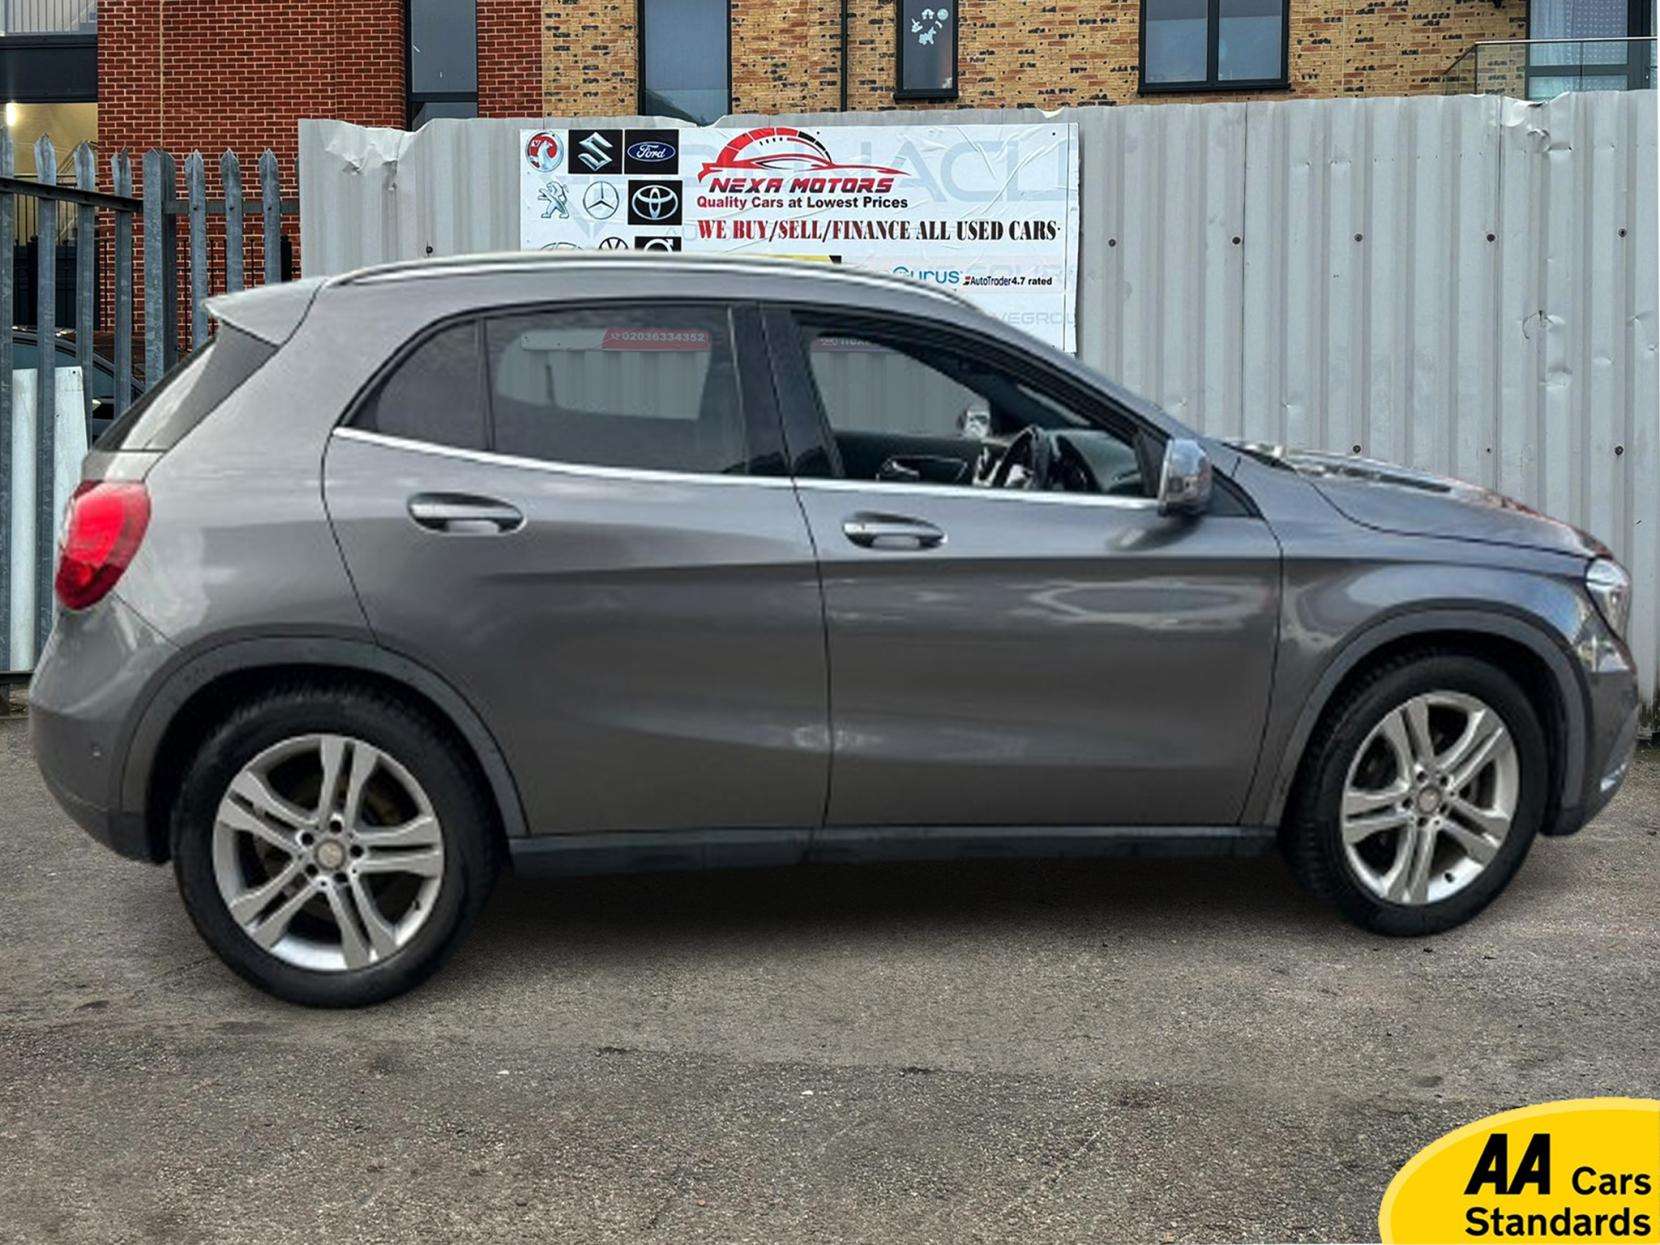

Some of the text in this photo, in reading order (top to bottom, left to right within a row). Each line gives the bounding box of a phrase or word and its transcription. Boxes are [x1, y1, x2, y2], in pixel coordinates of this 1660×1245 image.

[636, 144, 666, 158] Ford
[708, 178, 894, 194] NEXA MOTORS
[697, 196, 908, 210] Quality Cars at Lowest Prices
[697, 220, 727, 240] WE
[733, 220, 911, 242] BUY/SELL/FINANCE
[916, 220, 951, 240] ALL
[957, 220, 1004, 240] USED
[1009, 220, 1057, 240] CARS
[1028, 277, 1053, 286] rated
